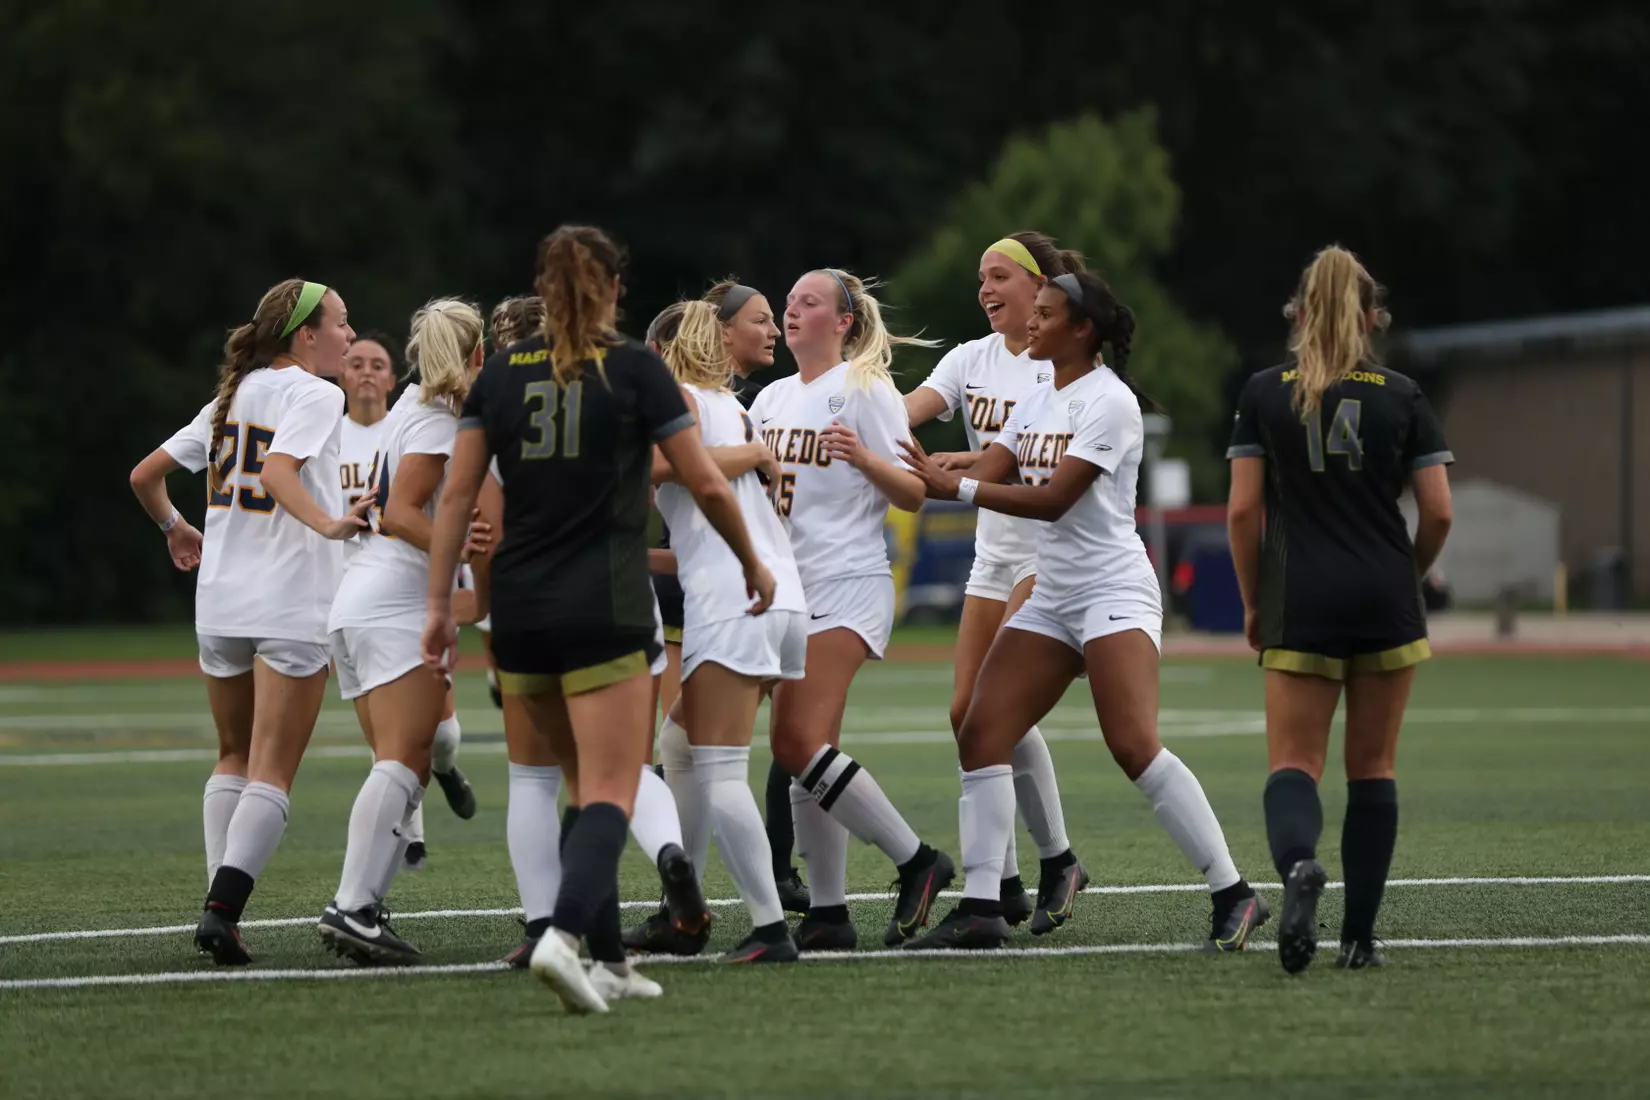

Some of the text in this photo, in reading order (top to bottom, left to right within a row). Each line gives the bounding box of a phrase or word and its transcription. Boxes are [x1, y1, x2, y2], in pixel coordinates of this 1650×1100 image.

[521, 380, 583, 460] 31
[1302, 399, 1364, 472] 14
[208, 421, 277, 514] 25
